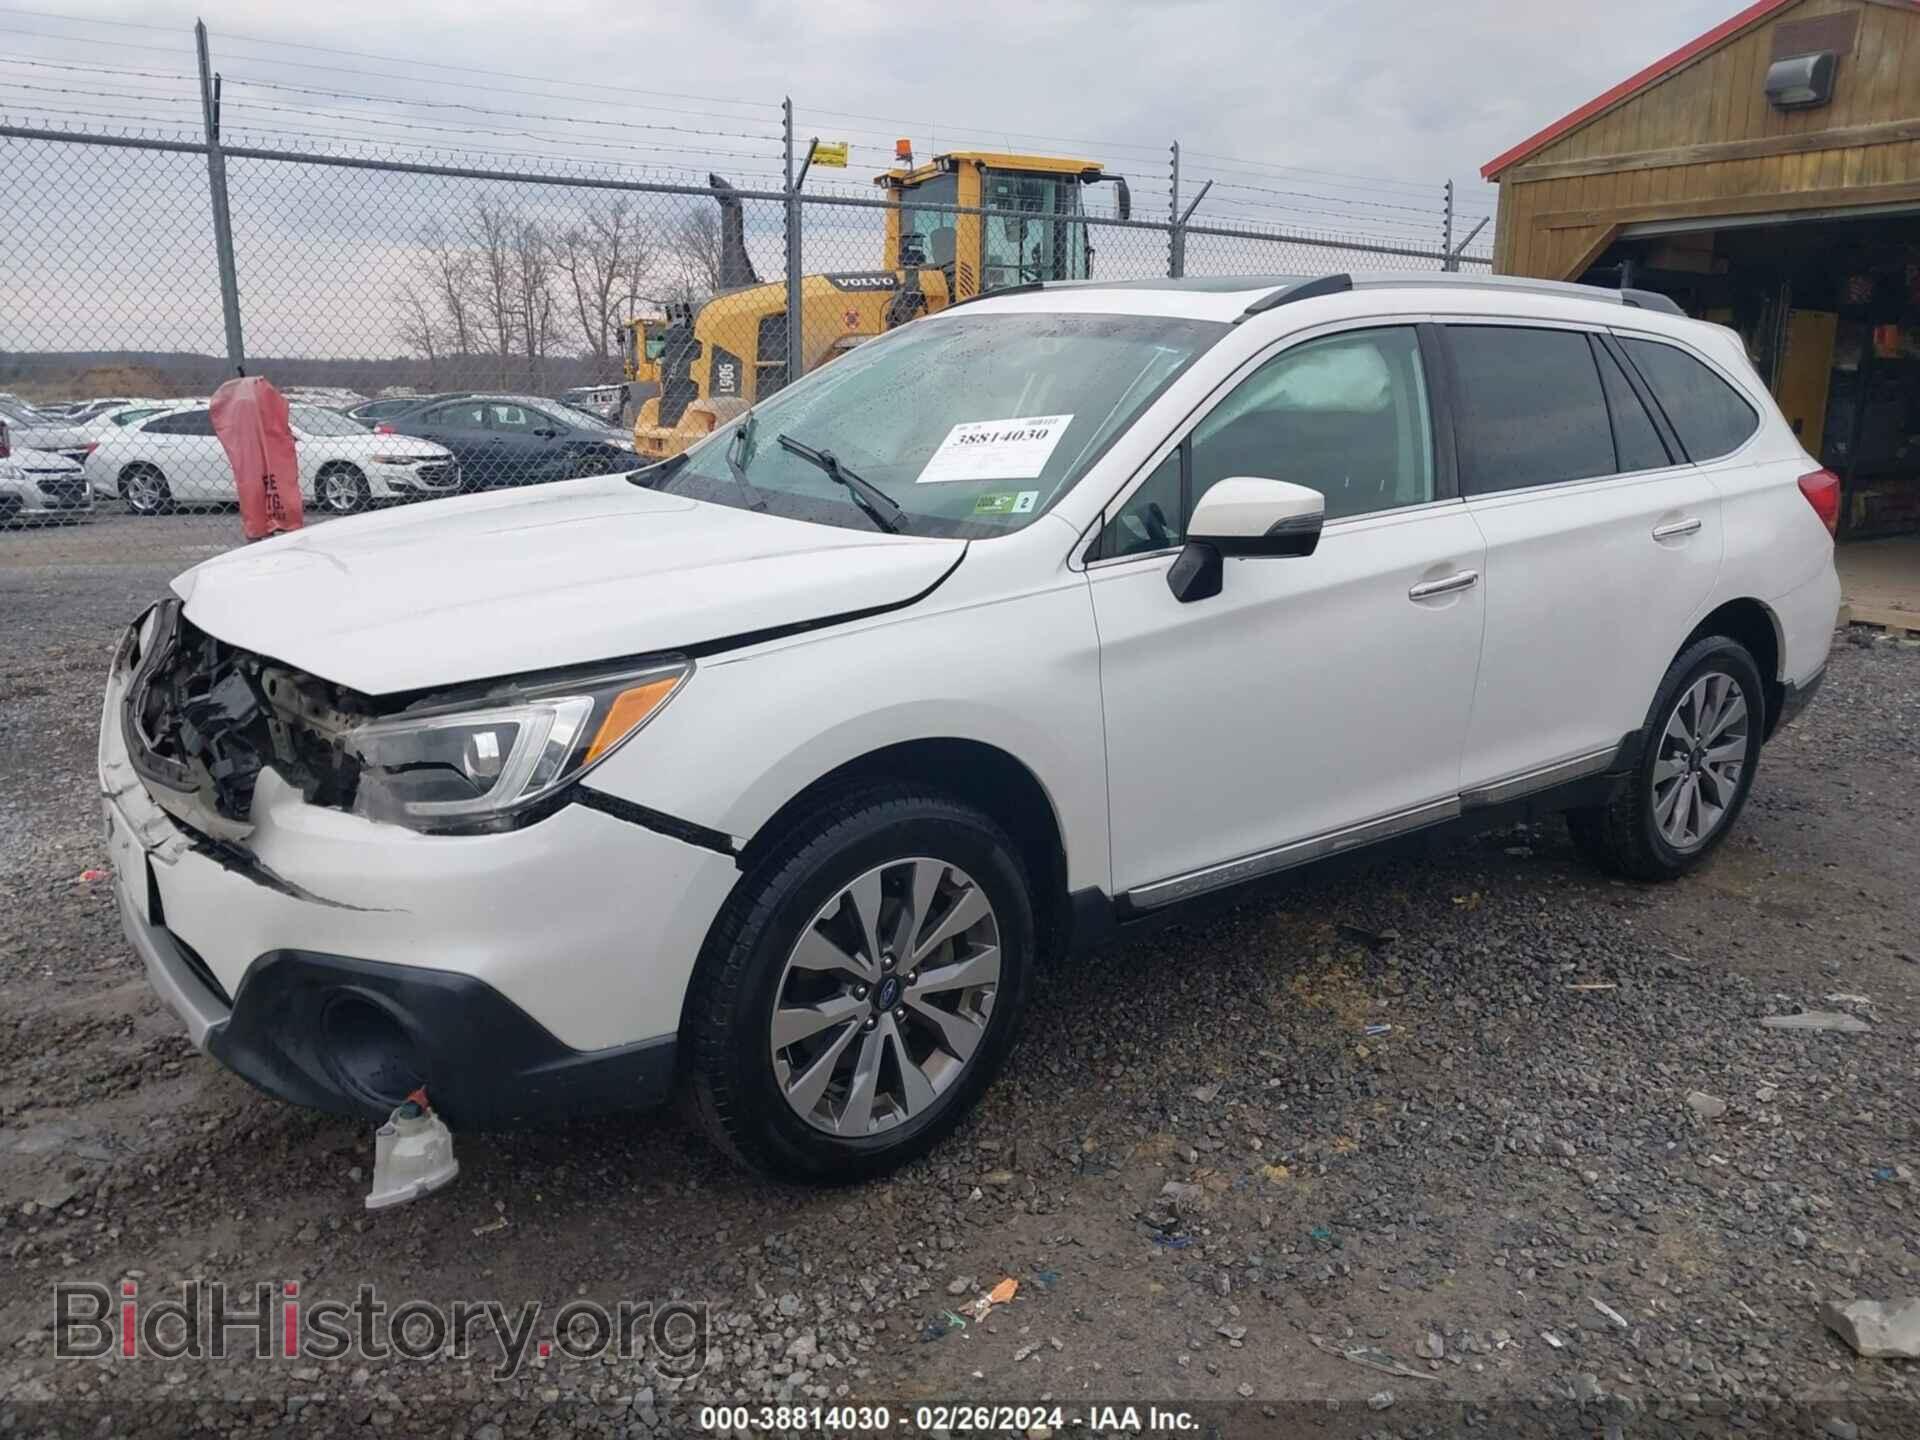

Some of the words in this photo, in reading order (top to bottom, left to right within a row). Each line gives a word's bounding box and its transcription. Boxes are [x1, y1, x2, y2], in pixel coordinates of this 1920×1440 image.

[835, 276, 894, 287] VOLVO
[718, 363, 736, 393] L90G
[952, 428, 1049, 447] 38814030
[1020, 496, 1030, 509] 2
